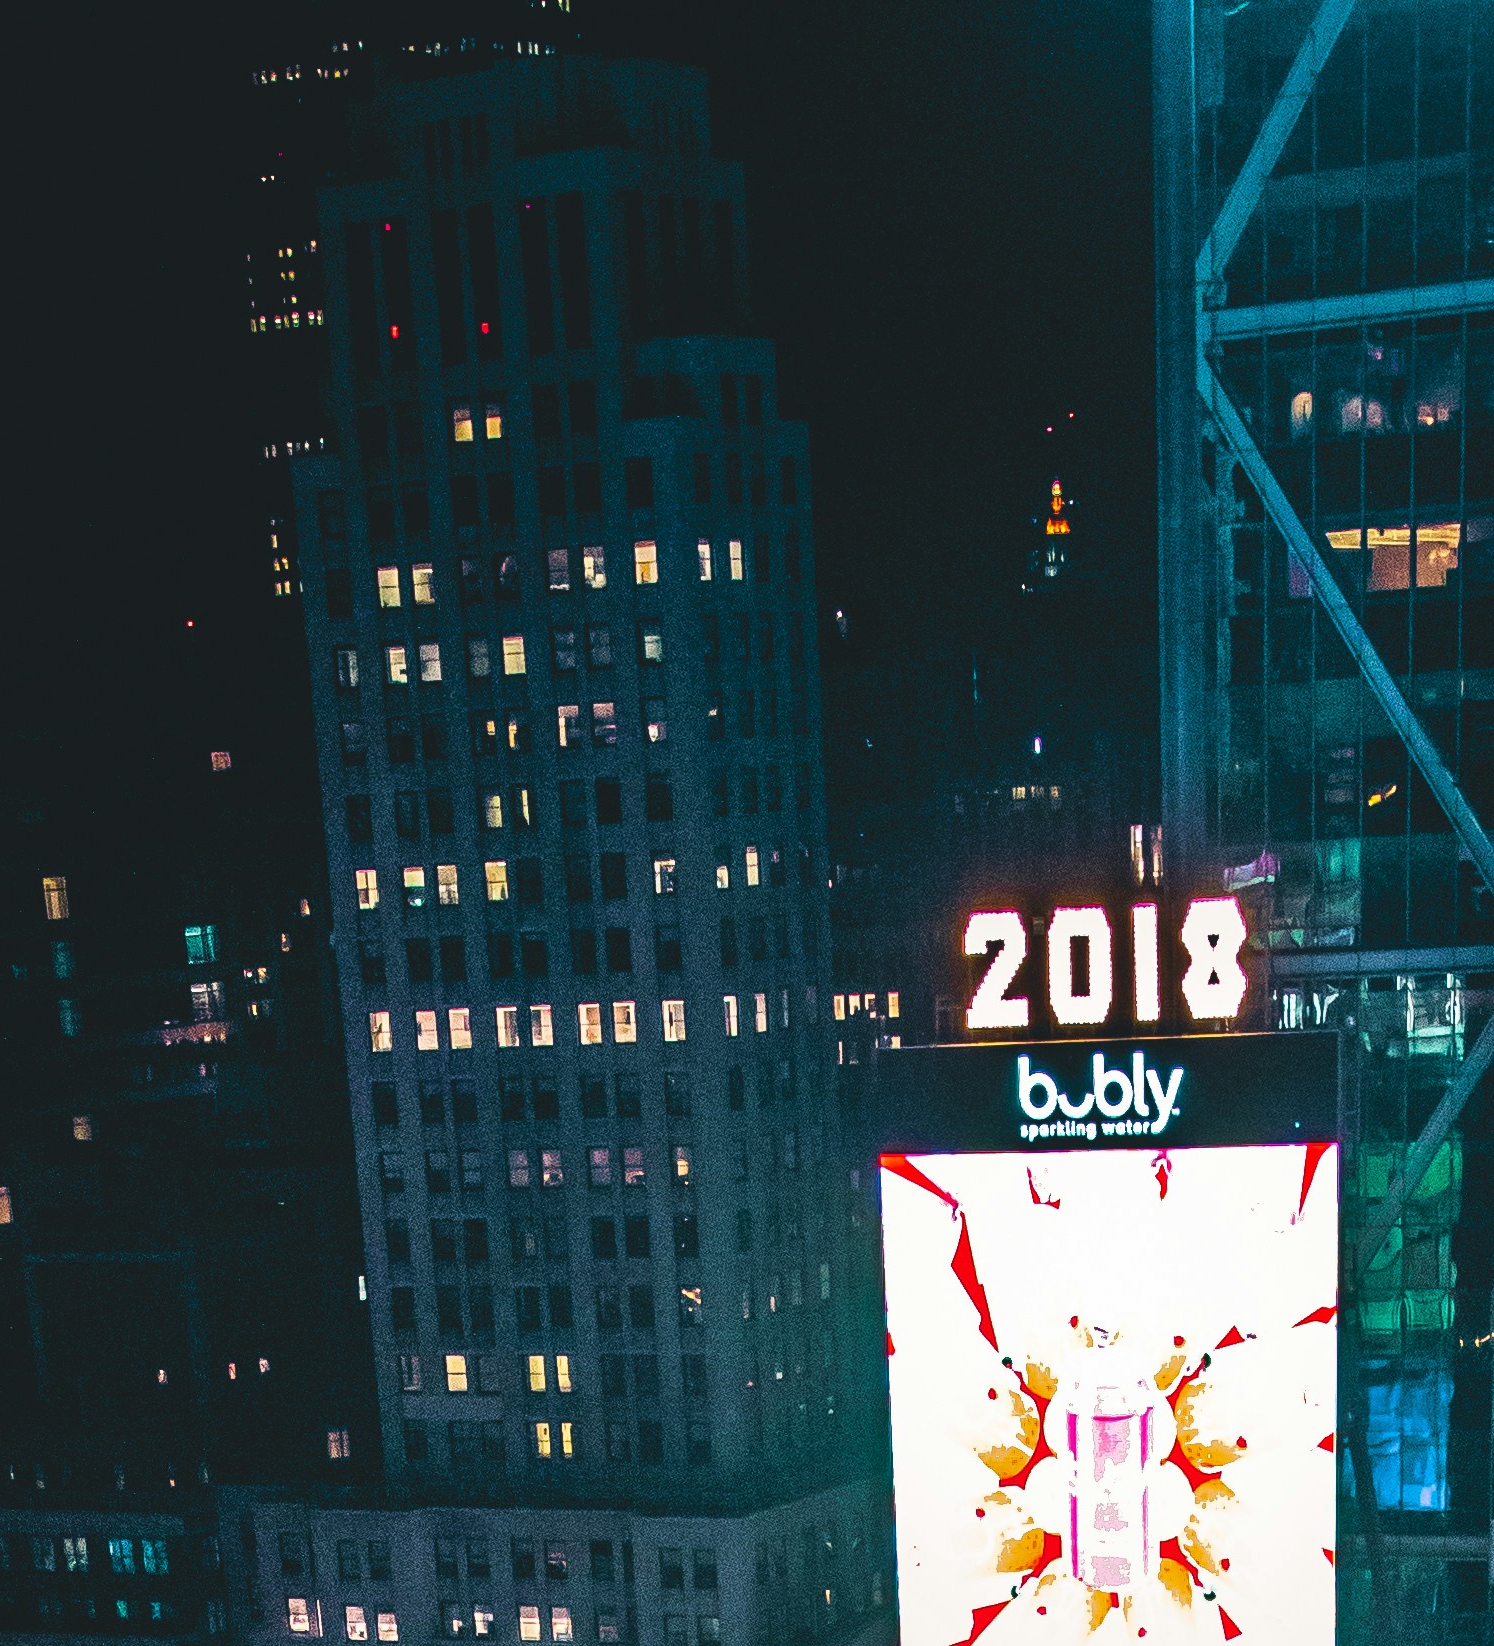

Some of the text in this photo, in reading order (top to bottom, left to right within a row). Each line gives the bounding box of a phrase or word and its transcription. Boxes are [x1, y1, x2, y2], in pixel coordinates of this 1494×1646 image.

[964, 898, 1248, 1029] 2018
[1020, 1120, 1153, 1141] sparkling water
